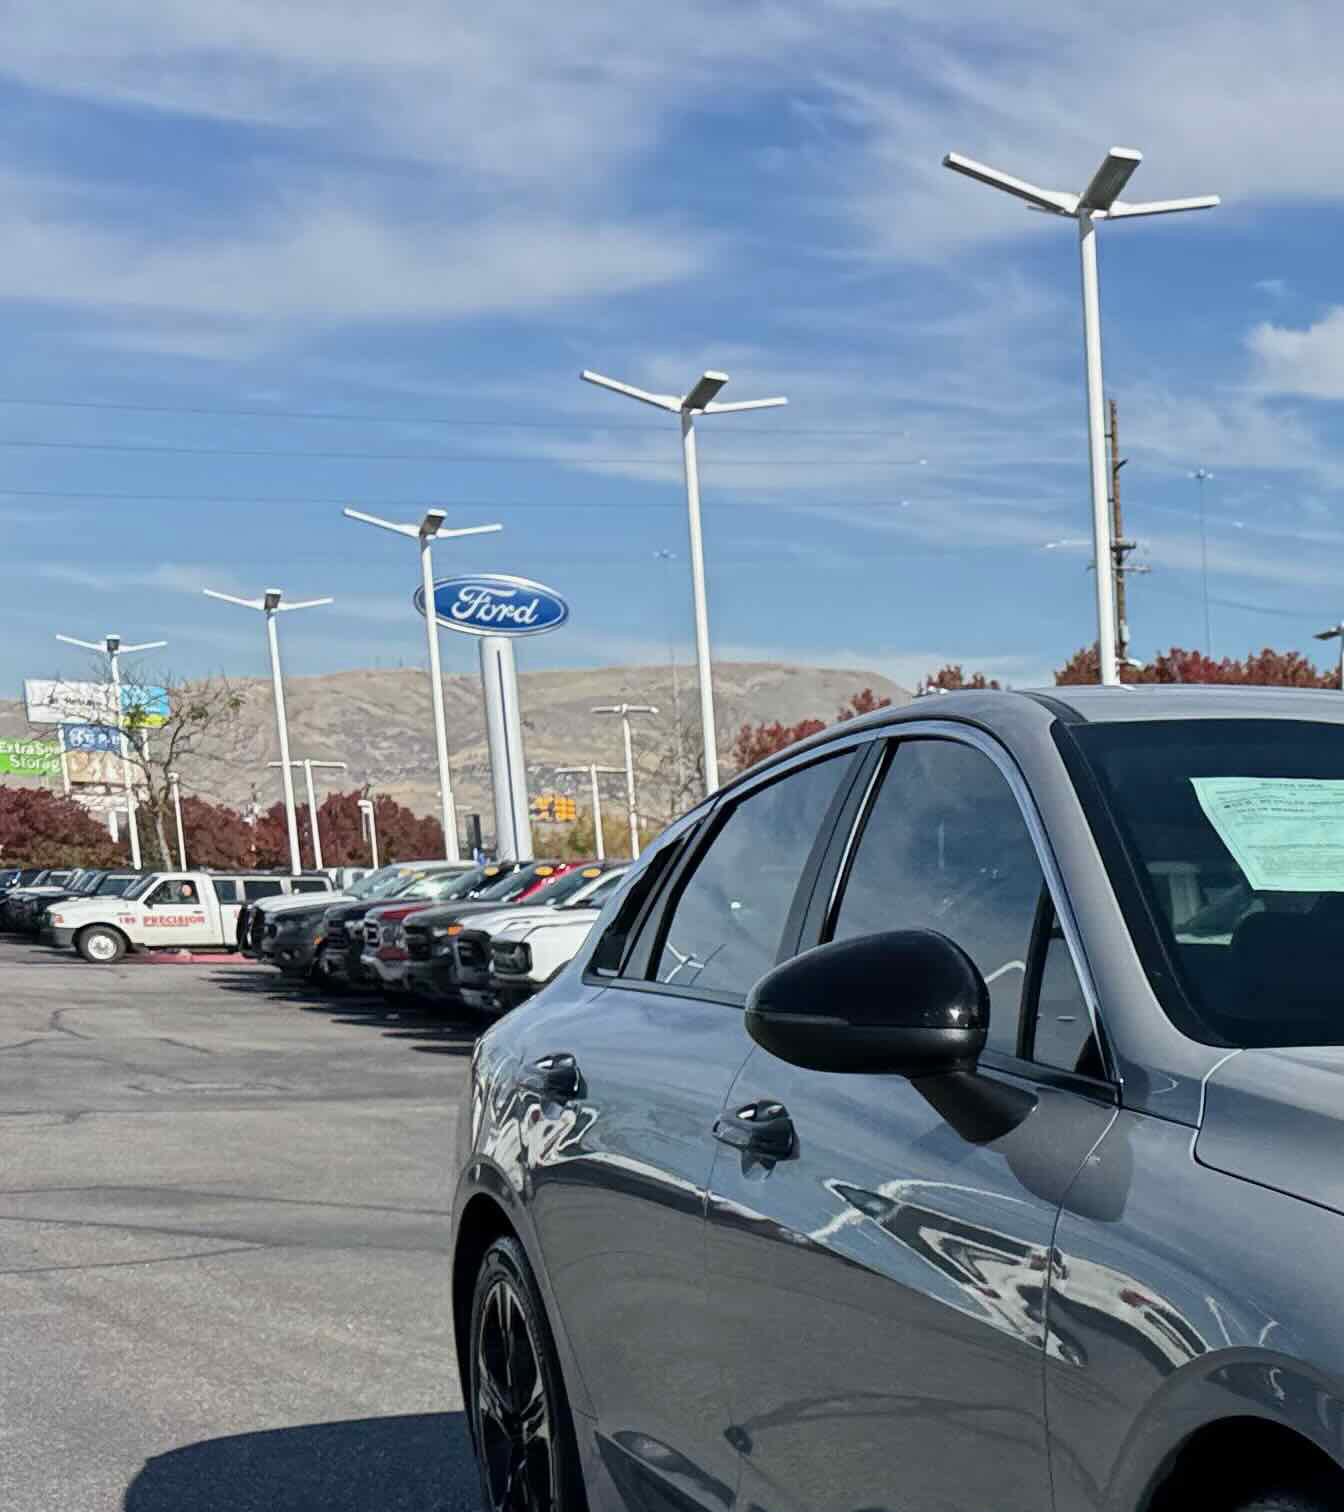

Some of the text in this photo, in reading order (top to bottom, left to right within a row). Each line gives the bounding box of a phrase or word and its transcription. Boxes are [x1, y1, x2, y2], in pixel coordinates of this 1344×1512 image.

[451, 585, 540, 625] Ford
[0, 741, 61, 758] ExtraSpa
[9, 753, 61, 773] Storag
[143, 915, 206, 925] PRECISION
